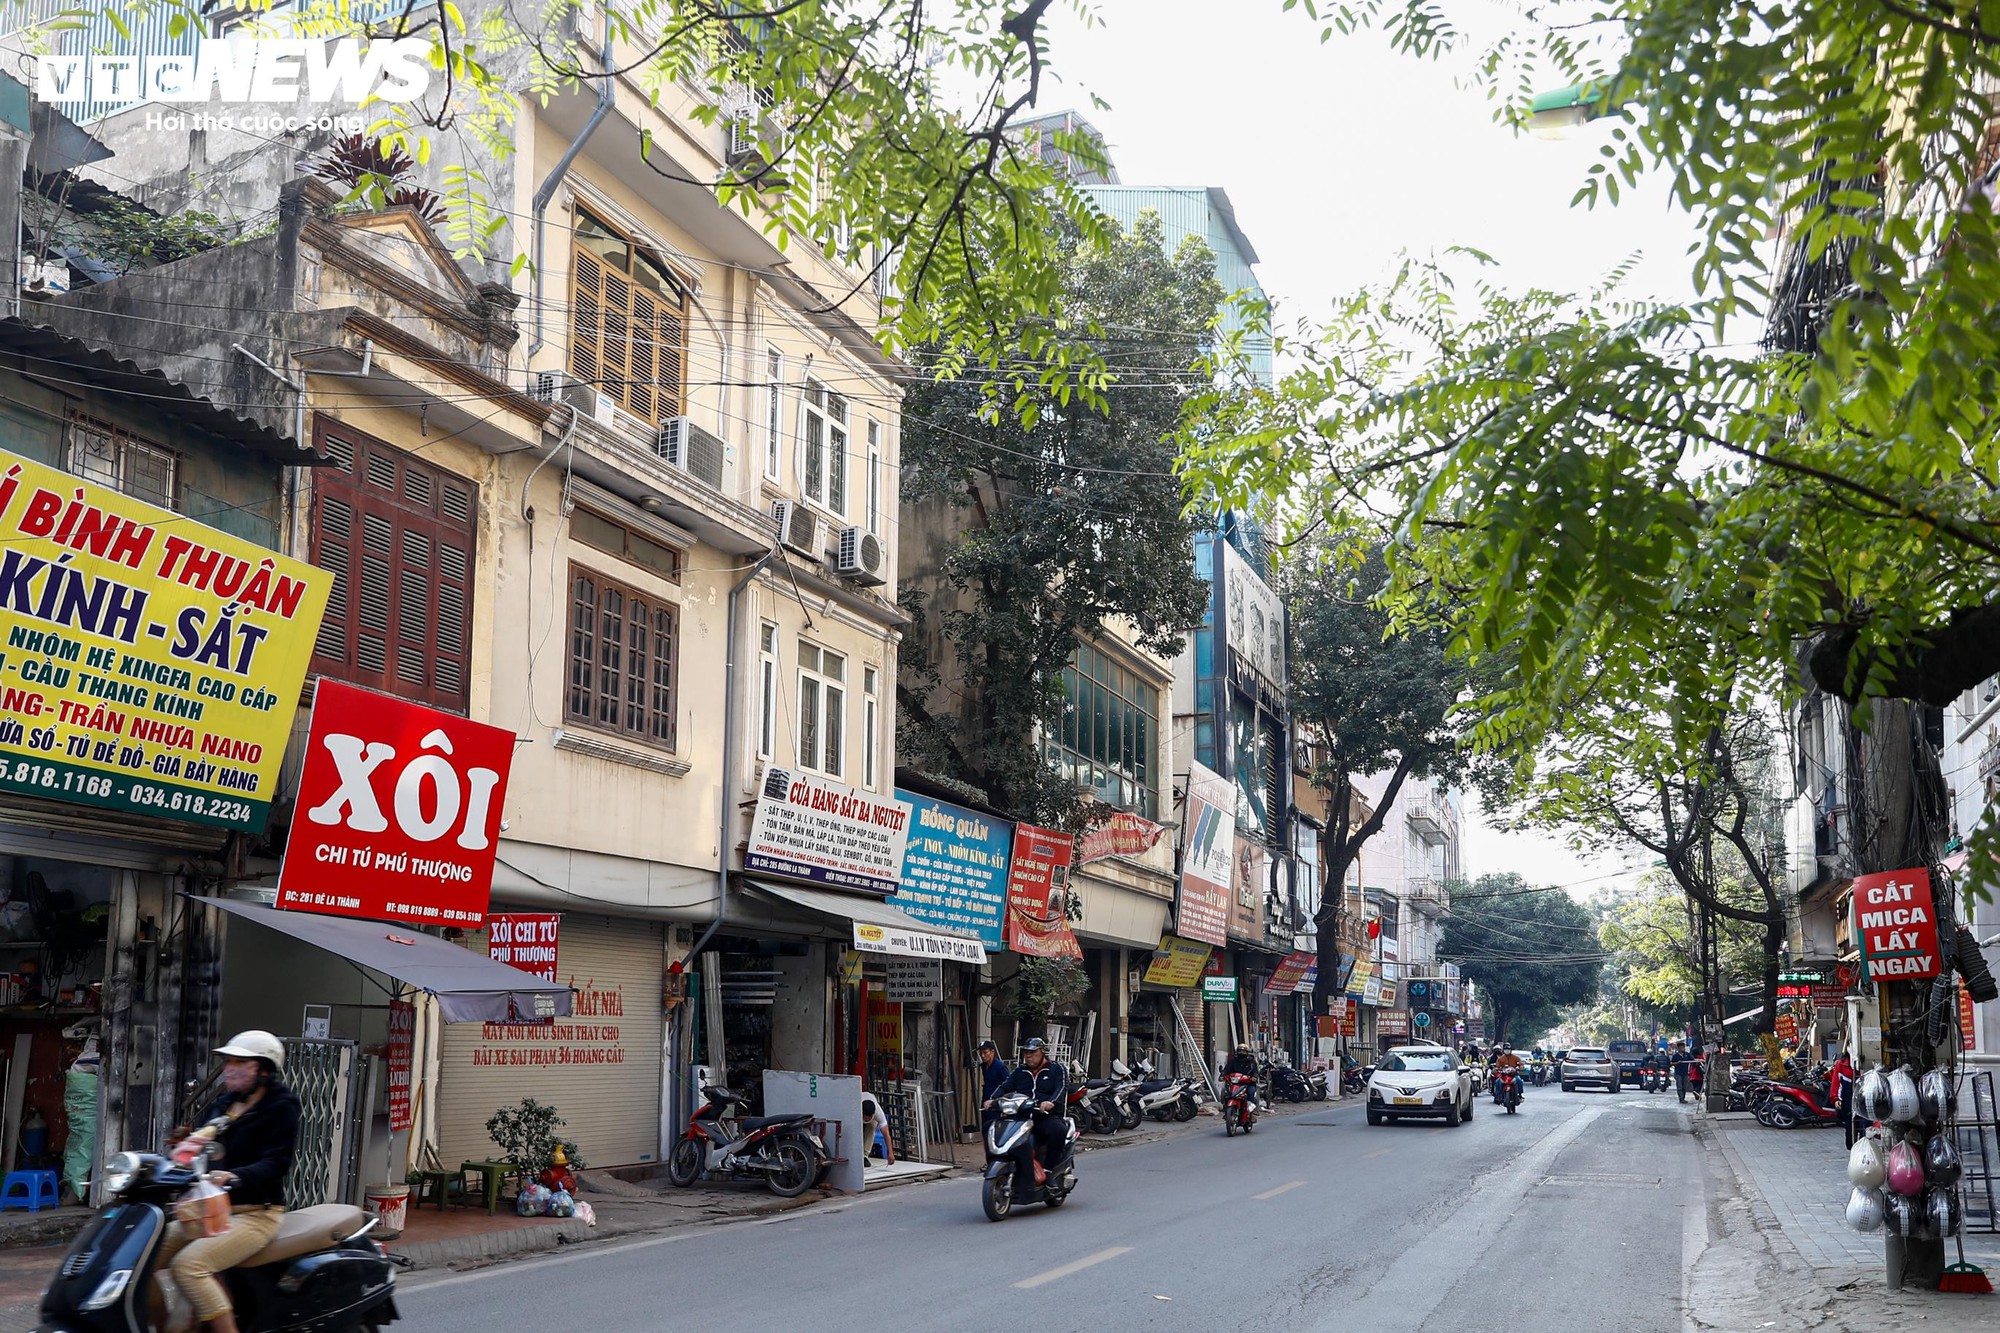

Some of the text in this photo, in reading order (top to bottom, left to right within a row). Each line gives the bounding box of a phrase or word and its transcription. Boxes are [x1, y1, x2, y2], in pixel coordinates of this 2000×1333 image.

[18, 488, 156, 569] BÌNH
[158, 537, 307, 620] THUẬN
[8, 626, 278, 712] NHÔM HỆ XINGFA CAO CẤP
[21, 656, 204, 721] CẦU THANG KÍNH
[130, 717, 195, 751] NHỰA
[200, 733, 262, 764] NANO
[217, 767, 259, 793] HÀNG
[308, 729, 500, 850] XÔI
[129, 784, 251, 823] 034.618.2234
[789, 776, 906, 837] CỬA HÀNG SẮT BA NGUYỆT
[766, 817, 778, 830] TÔN
[858, 839, 871, 851] THEO
[867, 828, 877, 842] CÁC
[919, 803, 955, 833] HỒNG
[956, 818, 990, 842] QUÂN
[314, 843, 473, 884] CHI TÚ PHÚ THƯỢNG
[923, 837, 1005, 870] INOX NHÔM KÍNH SẮT
[285, 890, 361, 909] ĐC: 281 ĐÊ LA THÀNH
[1866, 880, 1914, 905] CẮT
[386, 902, 397, 913] ĐT:
[397, 903, 410, 915] 098
[410, 905, 423, 916] 819
[443, 908, 456, 919] 039
[1861, 906, 1928, 929] MICA
[490, 916, 558, 943] XÔI CHI TÚ
[1873, 927, 1920, 952] LẤY
[490, 944, 556, 965] PHÚ THƯỢNG
[926, 935, 941, 954] TÔN
[1867, 955, 1933, 977] NGAY
[551, 1026, 573, 1041] SINH
[473, 1041, 625, 1069] BÃI XE SAI PHẠM 36 HOÀNG CẦU
